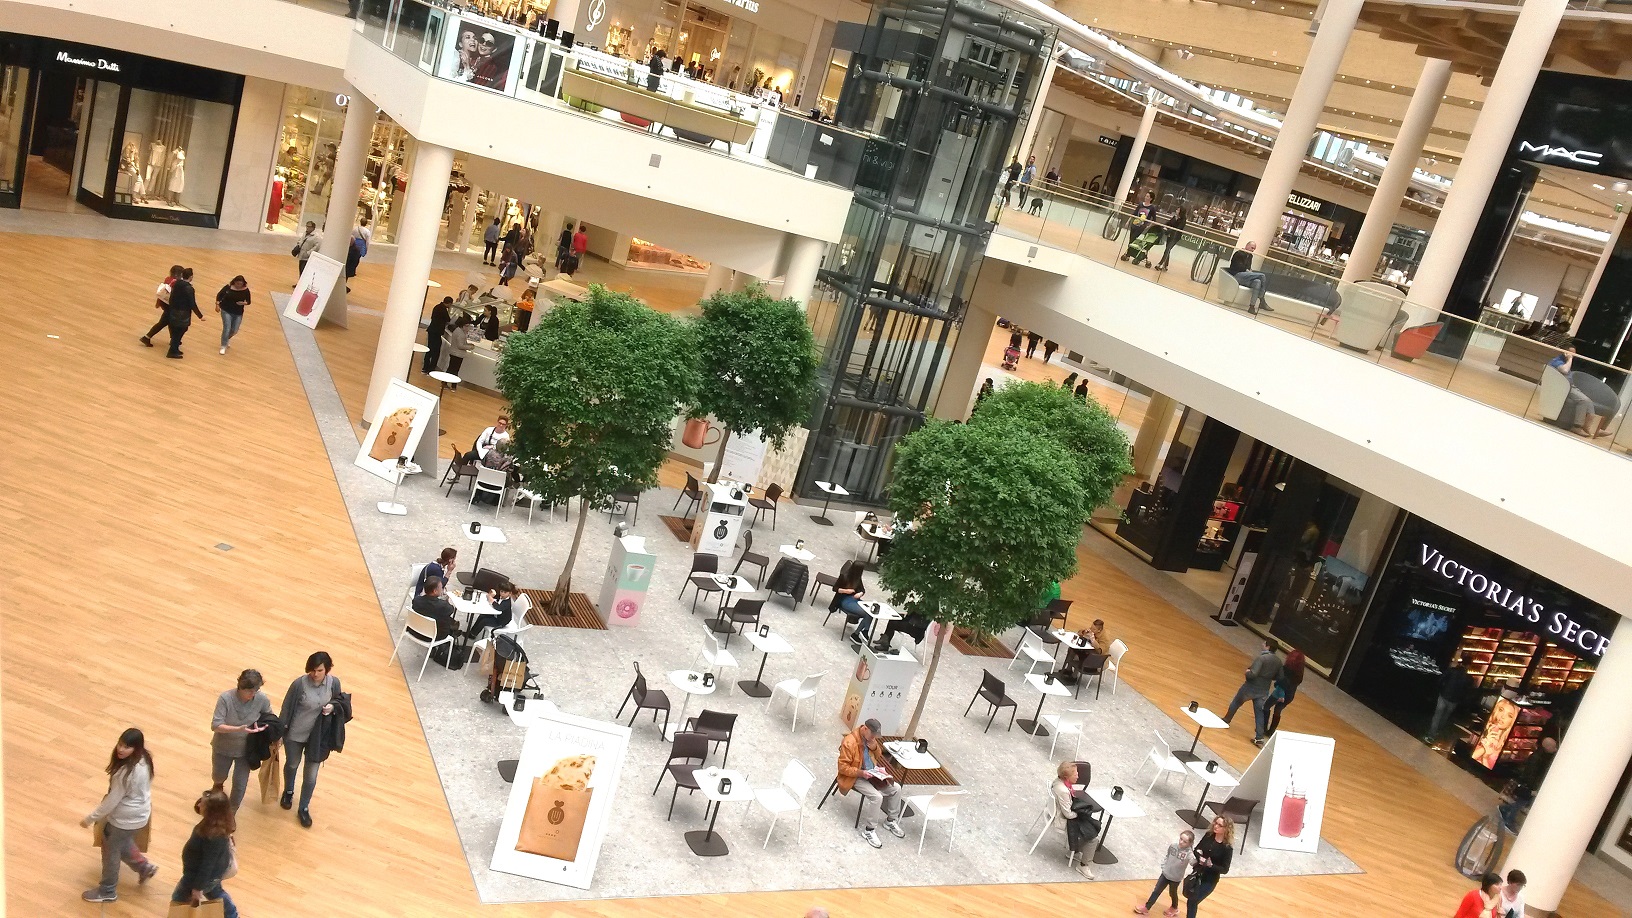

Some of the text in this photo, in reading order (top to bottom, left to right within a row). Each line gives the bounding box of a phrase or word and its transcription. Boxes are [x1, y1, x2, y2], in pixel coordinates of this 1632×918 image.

[56, 50, 120, 72] Massimo Dutti
[1421, 543, 1544, 623] VICTORIA'S
[1412, 598, 1438, 610] VICTORIA'S
